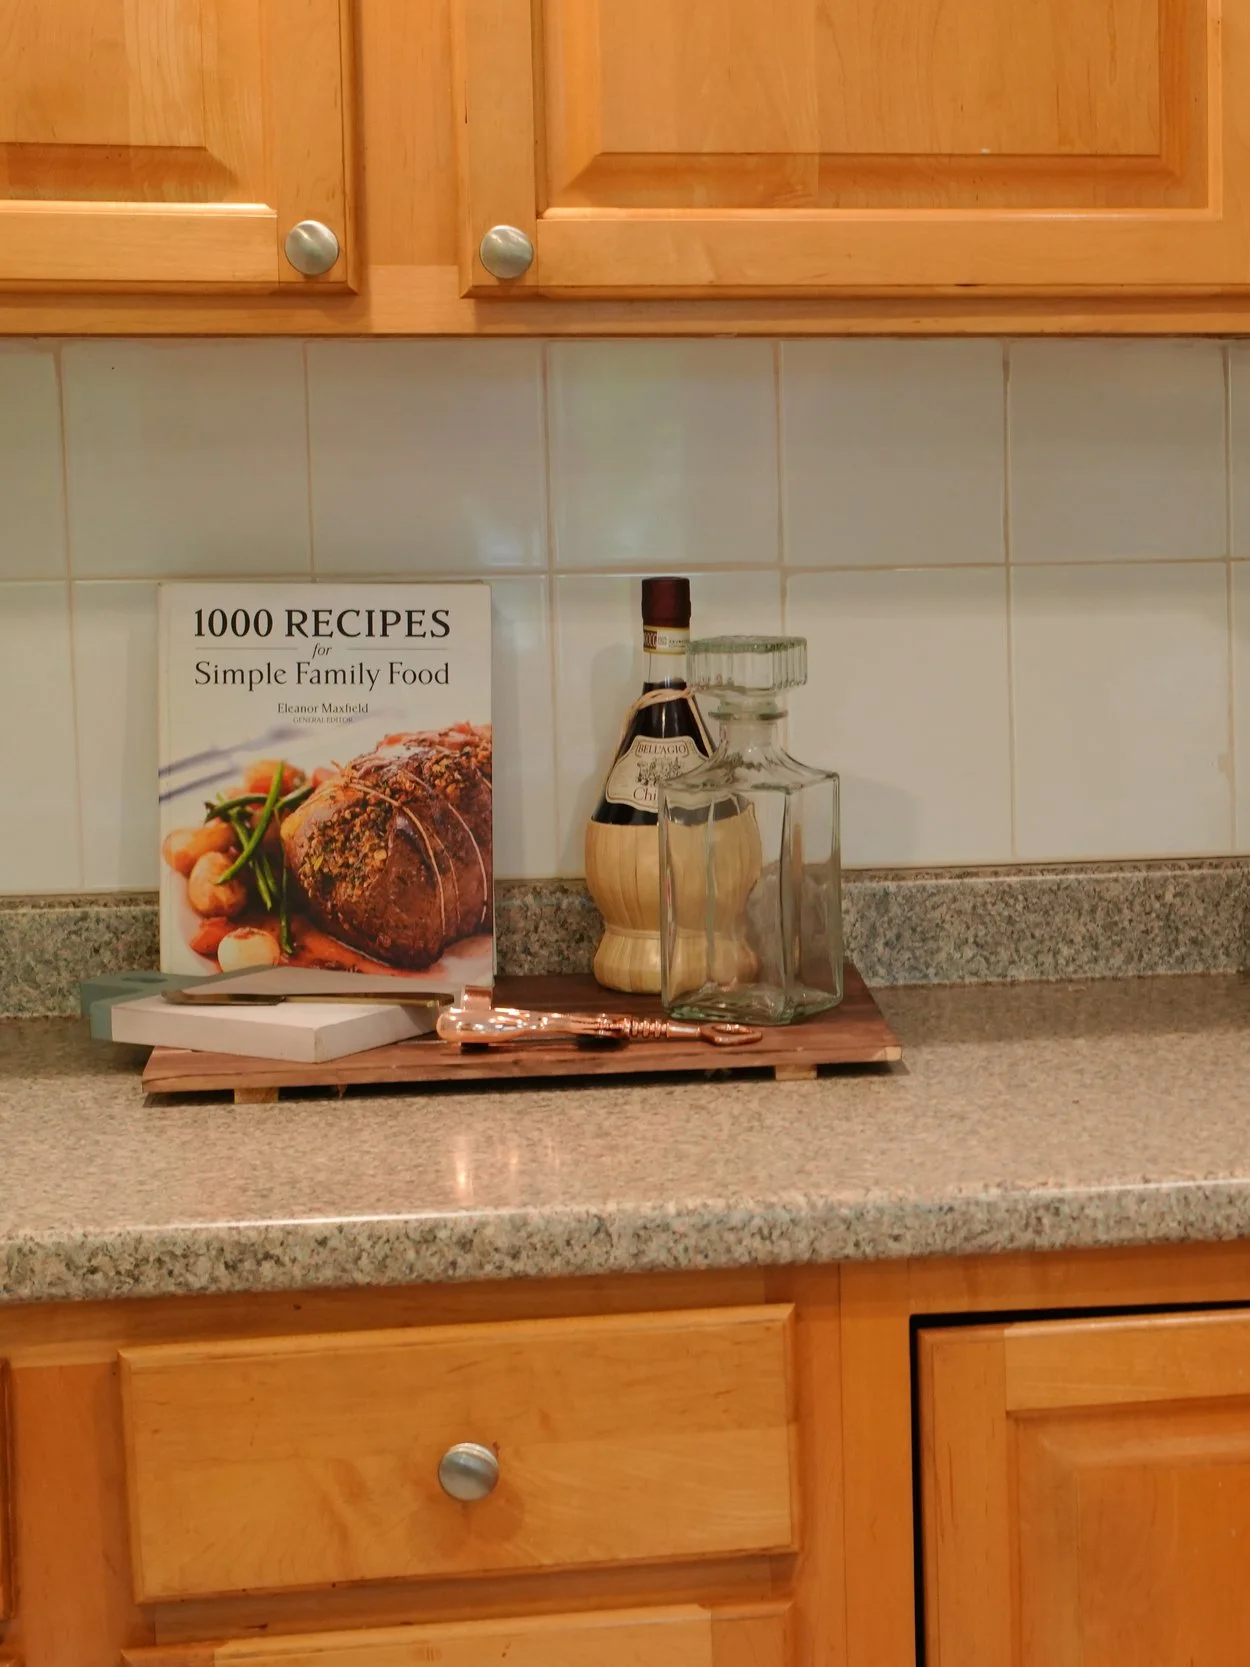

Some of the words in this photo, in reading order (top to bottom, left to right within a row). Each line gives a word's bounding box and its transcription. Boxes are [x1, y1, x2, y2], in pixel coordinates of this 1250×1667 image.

[194, 608, 273, 638] 1000
[285, 609, 450, 639] RECIPES
[311, 642, 333, 660] for
[195, 661, 288, 692] Simple
[296, 661, 381, 692] Family
[389, 661, 449, 685] Food
[277, 703, 317, 713] Eleanor
[322, 703, 369, 713] Maxfield
[293, 716, 325, 724] GENERAL
[326, 716, 354, 724] EDITOR
